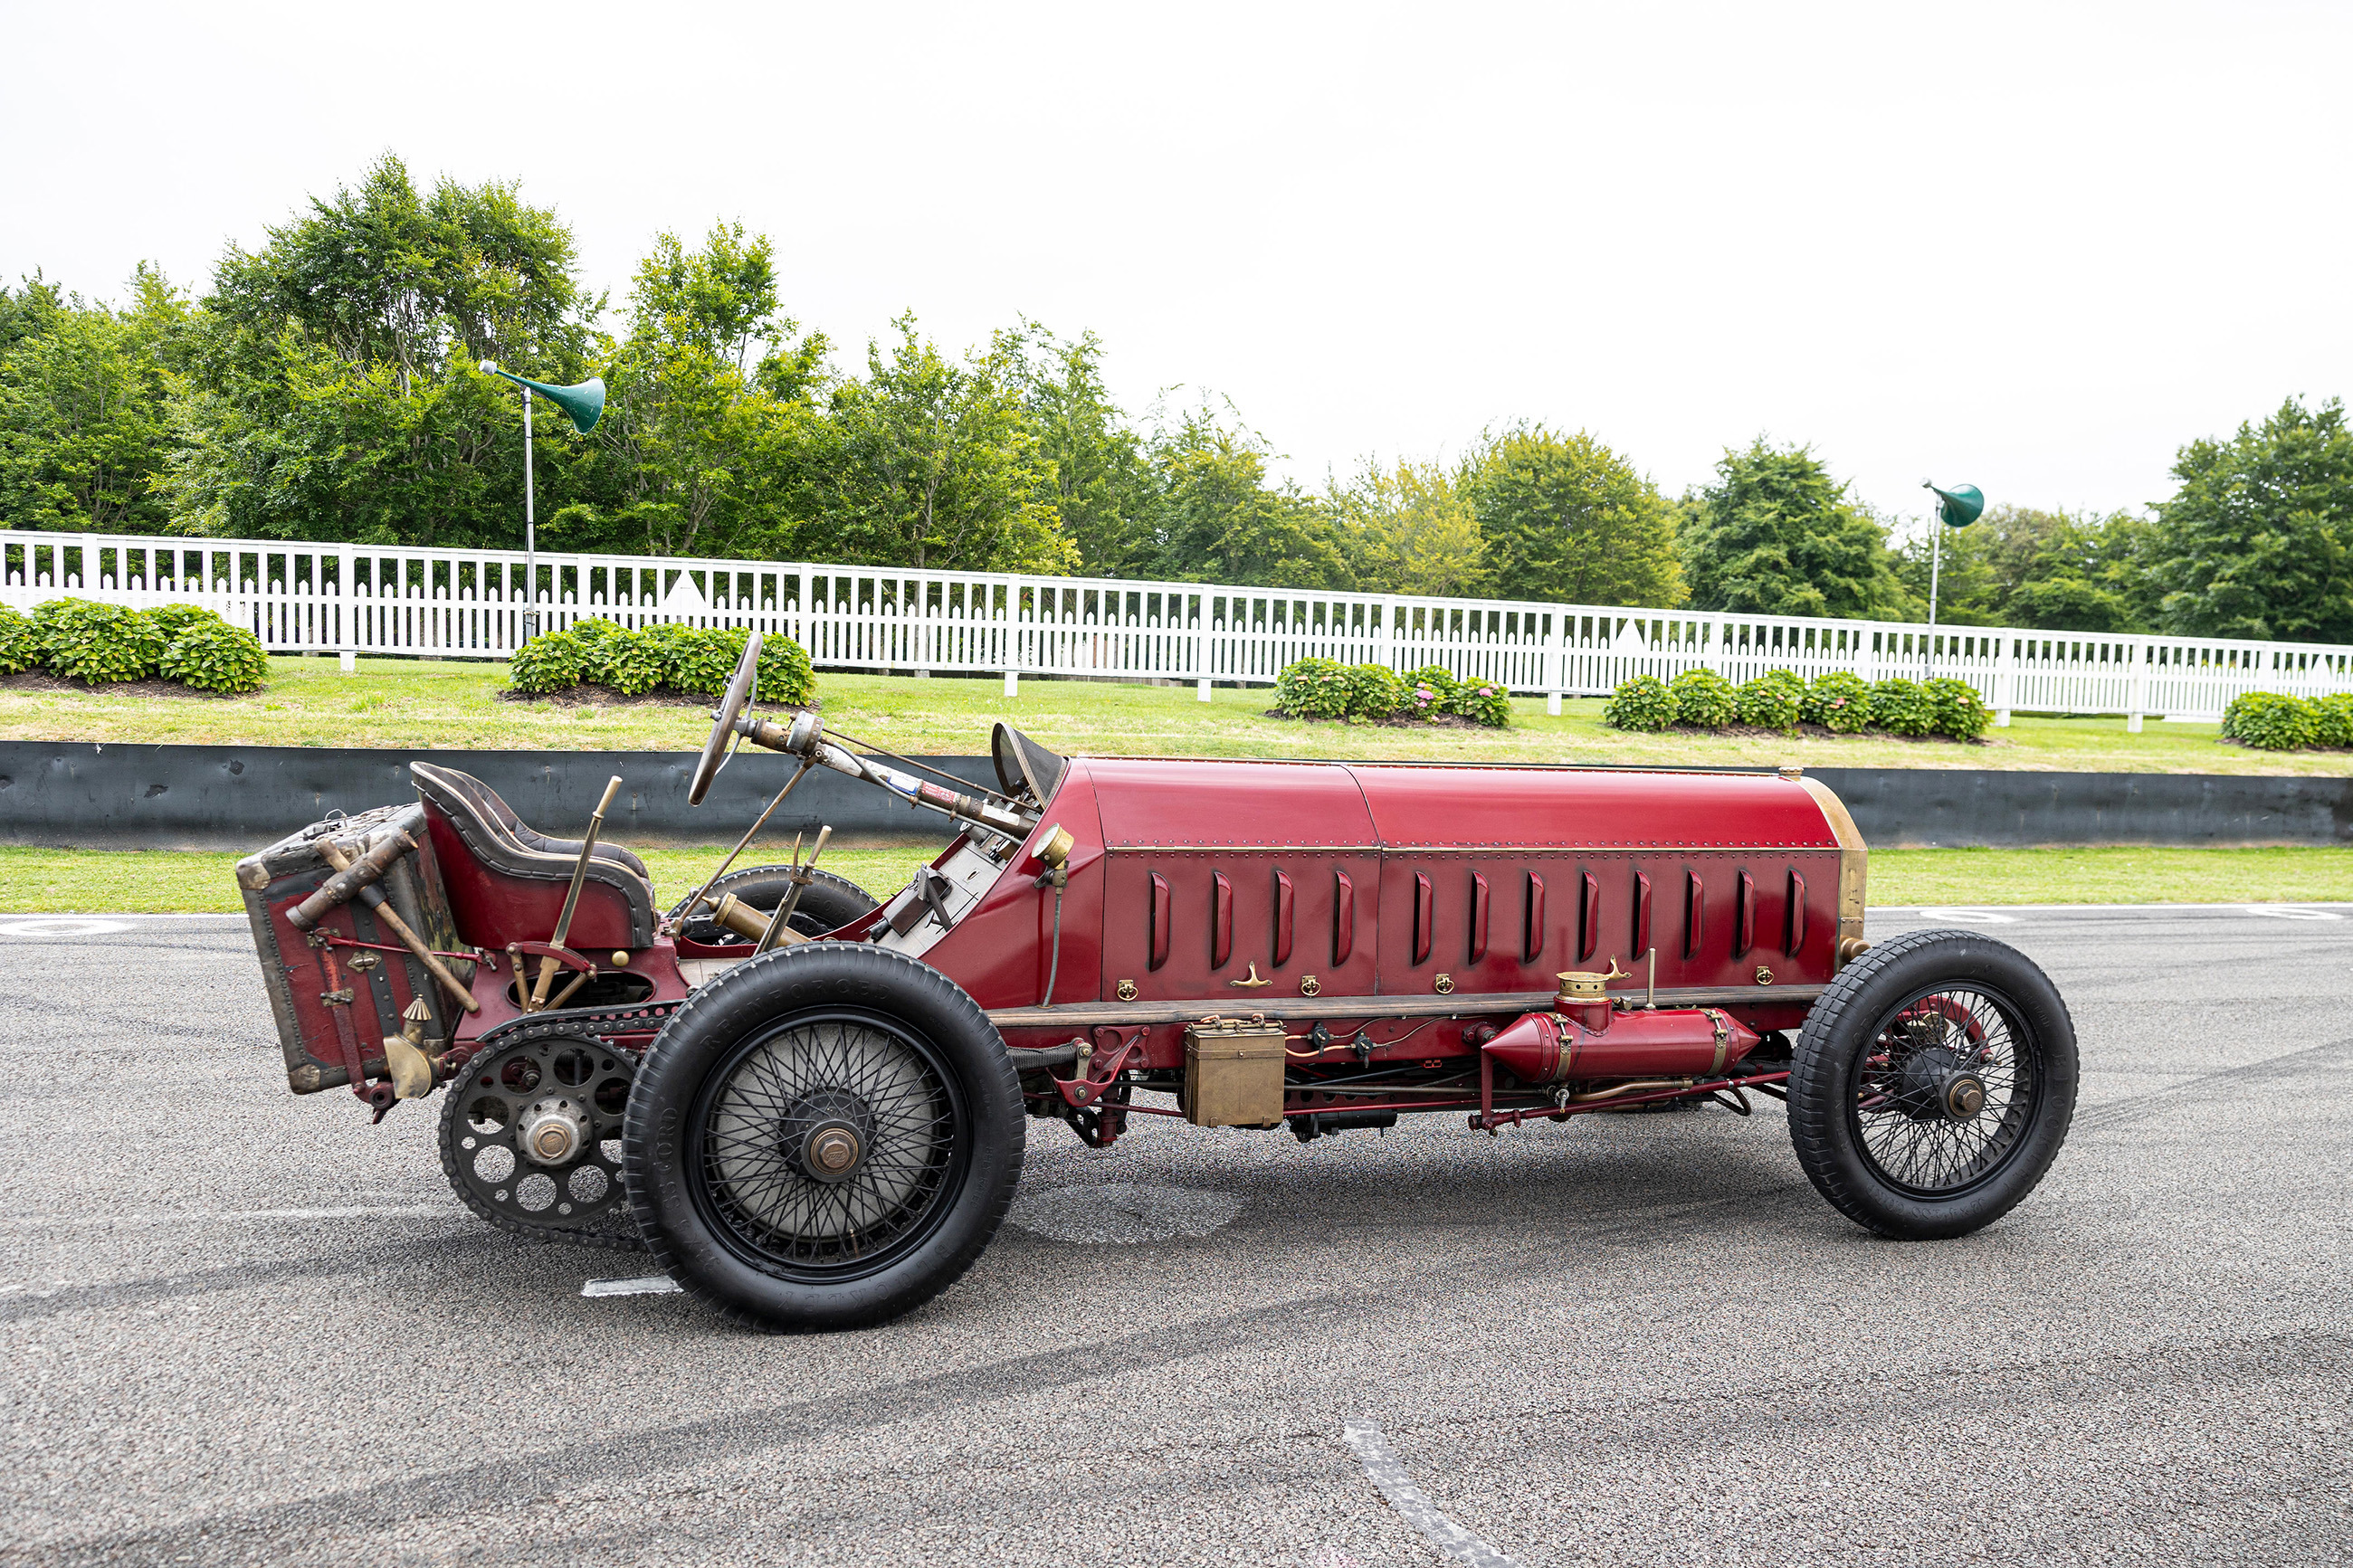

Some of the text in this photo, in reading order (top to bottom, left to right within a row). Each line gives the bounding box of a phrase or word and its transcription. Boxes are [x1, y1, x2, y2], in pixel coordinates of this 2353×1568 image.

[699, 978, 892, 1050] REINFORCED
[1834, 1004, 1882, 1155] REINFORCED
[655, 1107, 678, 1174] CORD
[2002, 1053, 2068, 1196] BLOCKLEY
[777, 1240, 952, 1311] BLOCKLEY
